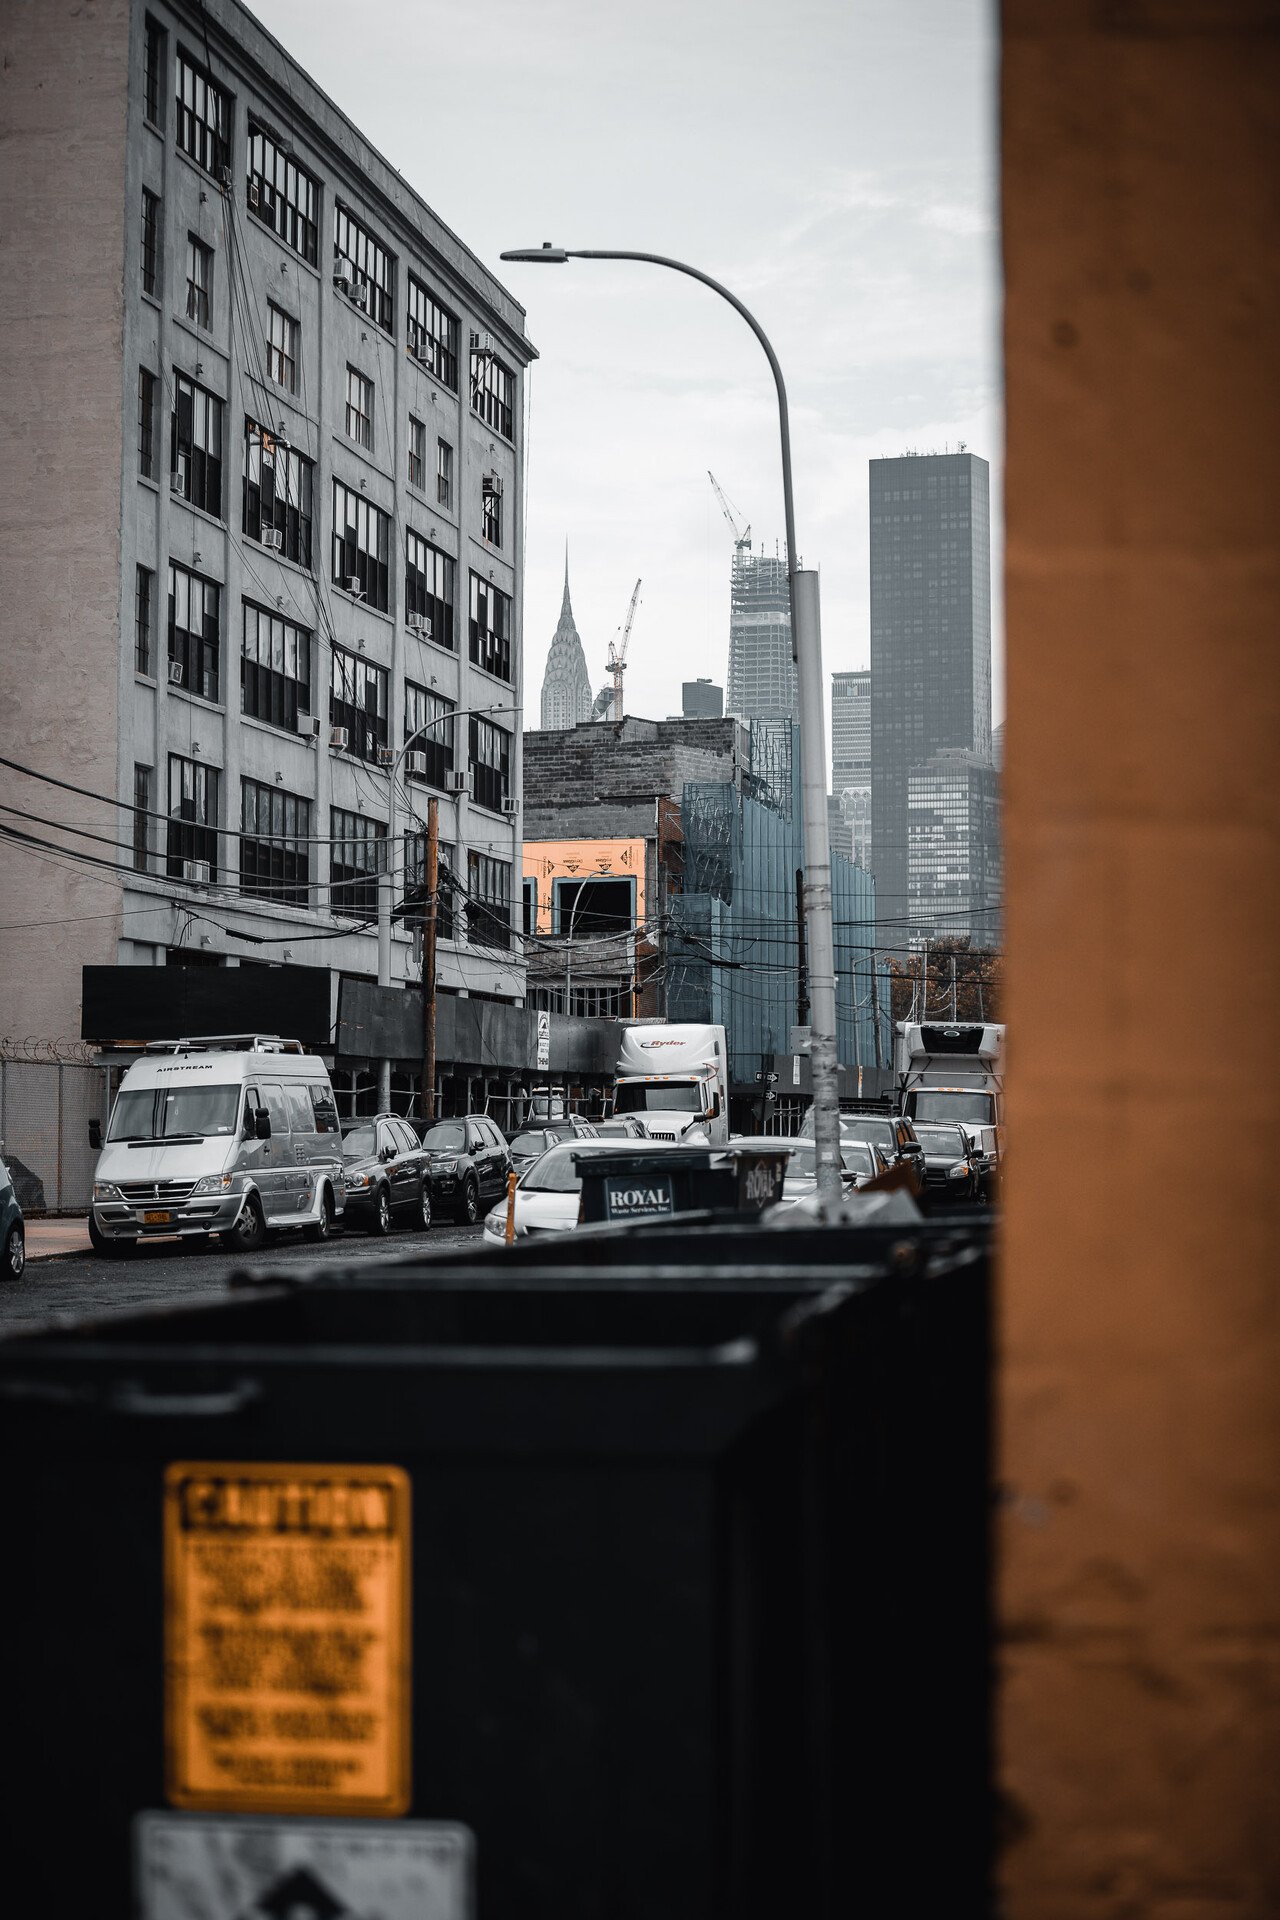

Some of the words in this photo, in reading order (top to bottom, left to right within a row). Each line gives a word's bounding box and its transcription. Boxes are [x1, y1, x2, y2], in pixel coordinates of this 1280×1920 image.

[156, 1065, 213, 1073] AIRSTREAM
[610, 1188, 670, 1207] ROYAL
[611, 1207, 630, 1215] Waste
[630, 1206, 657, 1214] Services,
[658, 1204, 671, 1212] Inc.
